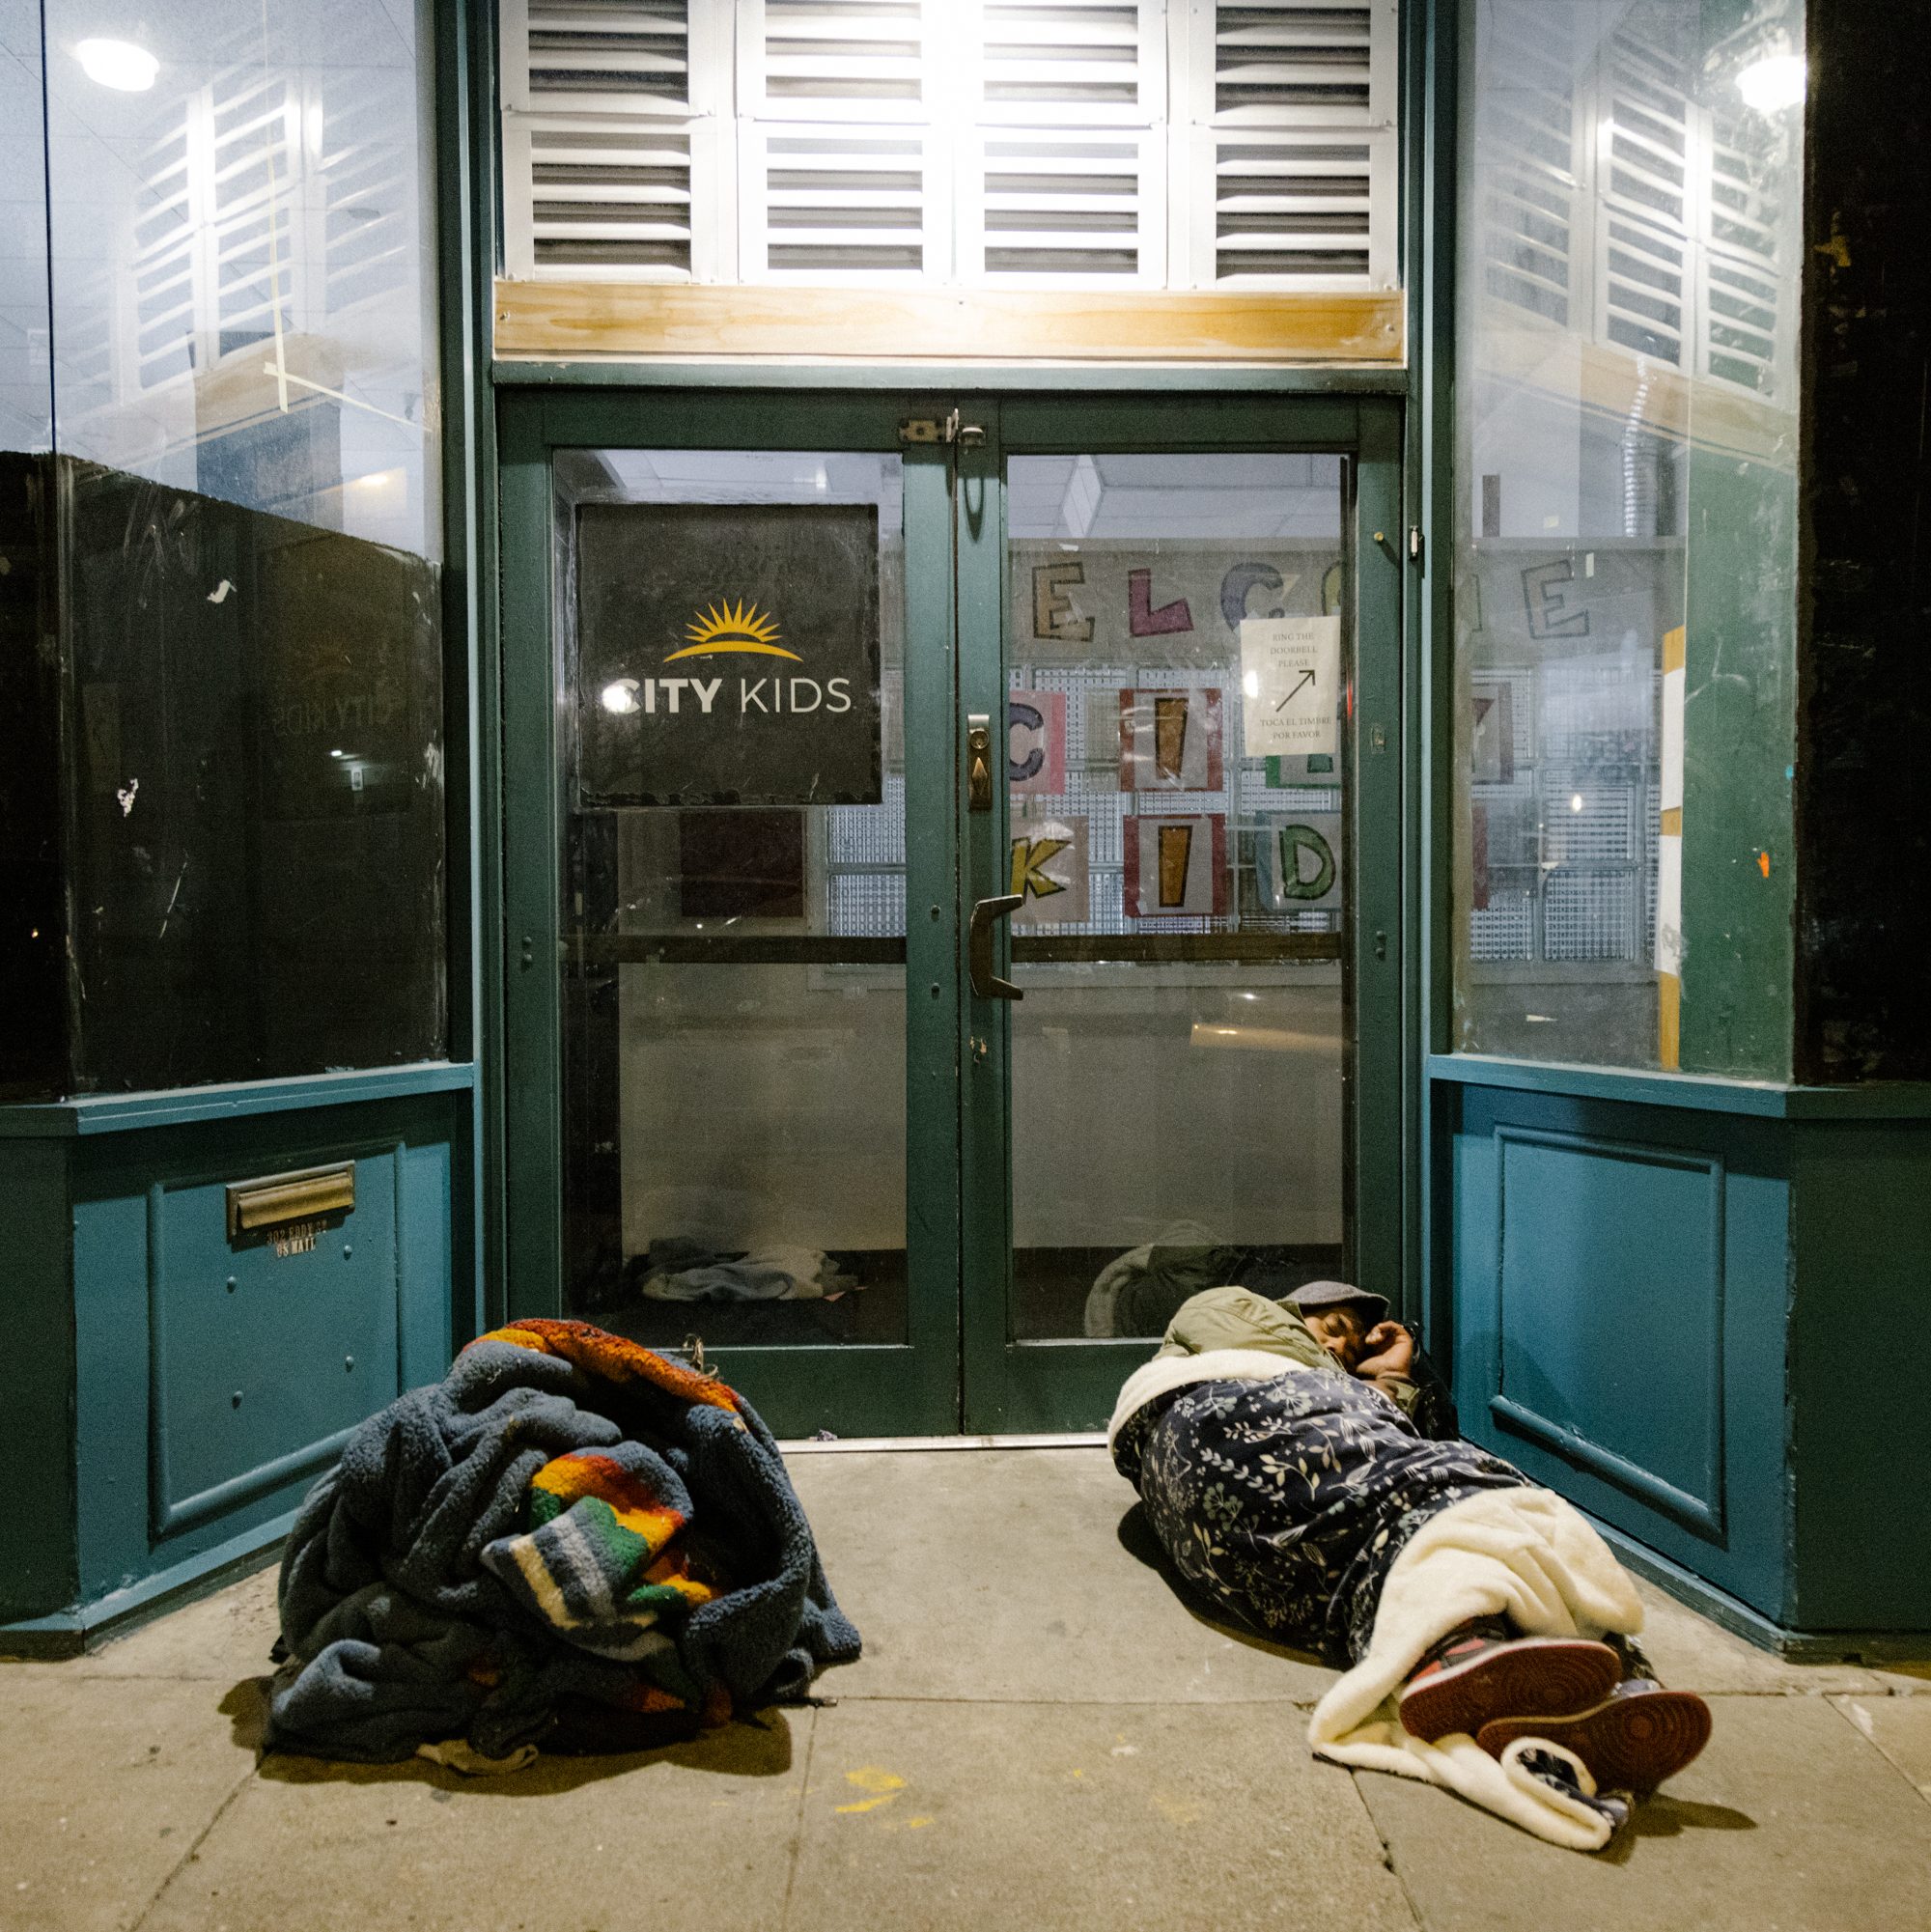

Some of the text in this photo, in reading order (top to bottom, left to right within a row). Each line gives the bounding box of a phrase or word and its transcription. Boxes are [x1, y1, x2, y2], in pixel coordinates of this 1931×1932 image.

[1273, 631, 1315, 642] RING THE
[1270, 645, 1318, 656] DOORBELL
[1277, 658, 1311, 668] PLEASE
[741, 678, 852, 714] KIDS
[1259, 715, 1332, 727] TOCA EL TIMBRE
[1273, 730, 1322, 741] POR FAVOR
[276, 1236, 316, 1258] US MAIL
